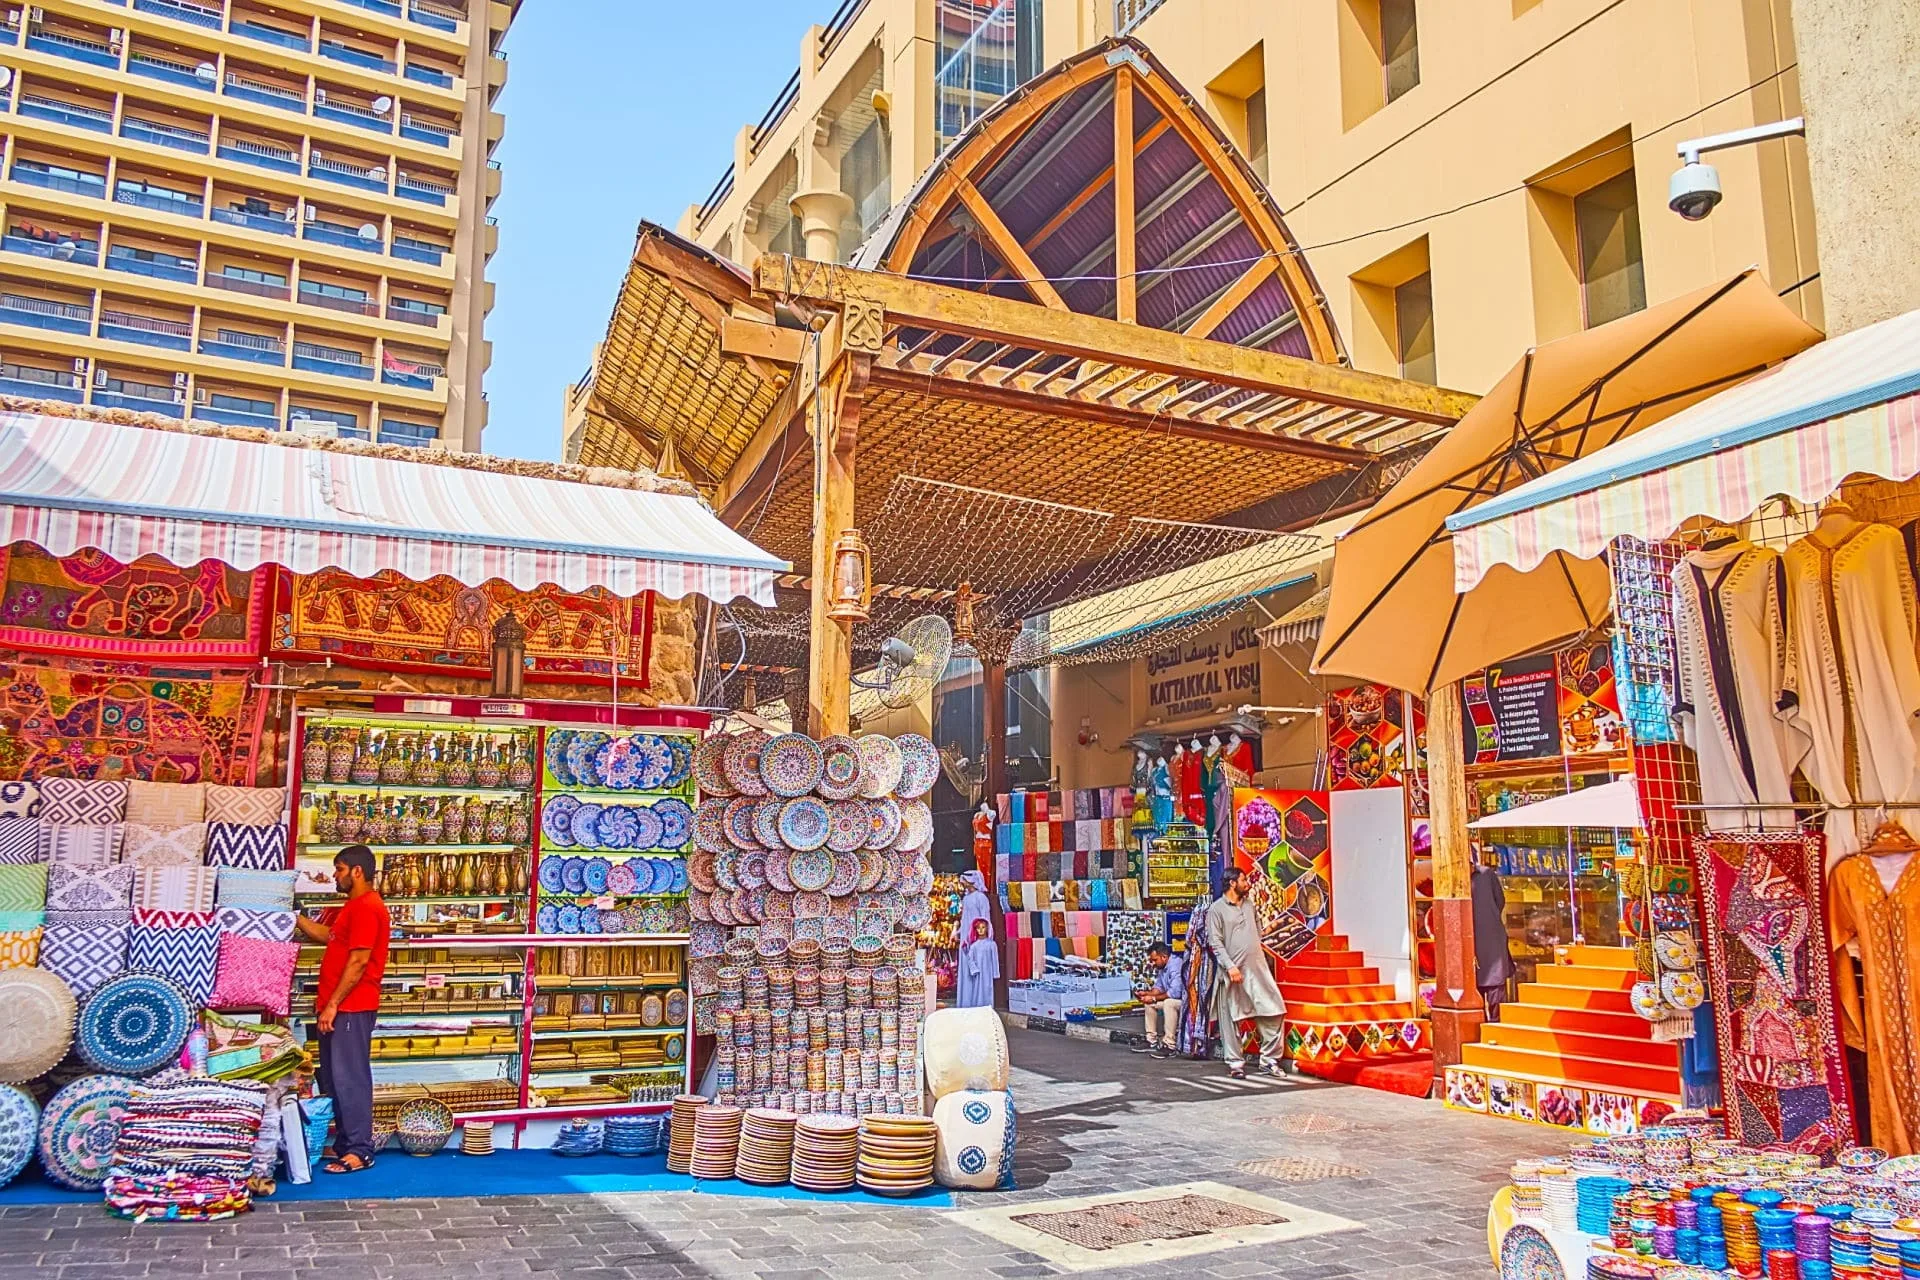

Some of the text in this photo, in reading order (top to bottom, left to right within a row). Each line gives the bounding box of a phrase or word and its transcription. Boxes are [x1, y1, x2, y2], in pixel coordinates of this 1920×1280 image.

[1490, 668, 1502, 688] 7
[1150, 671, 1222, 706] KATTAKKAL
[1166, 697, 1213, 716] TRADING
